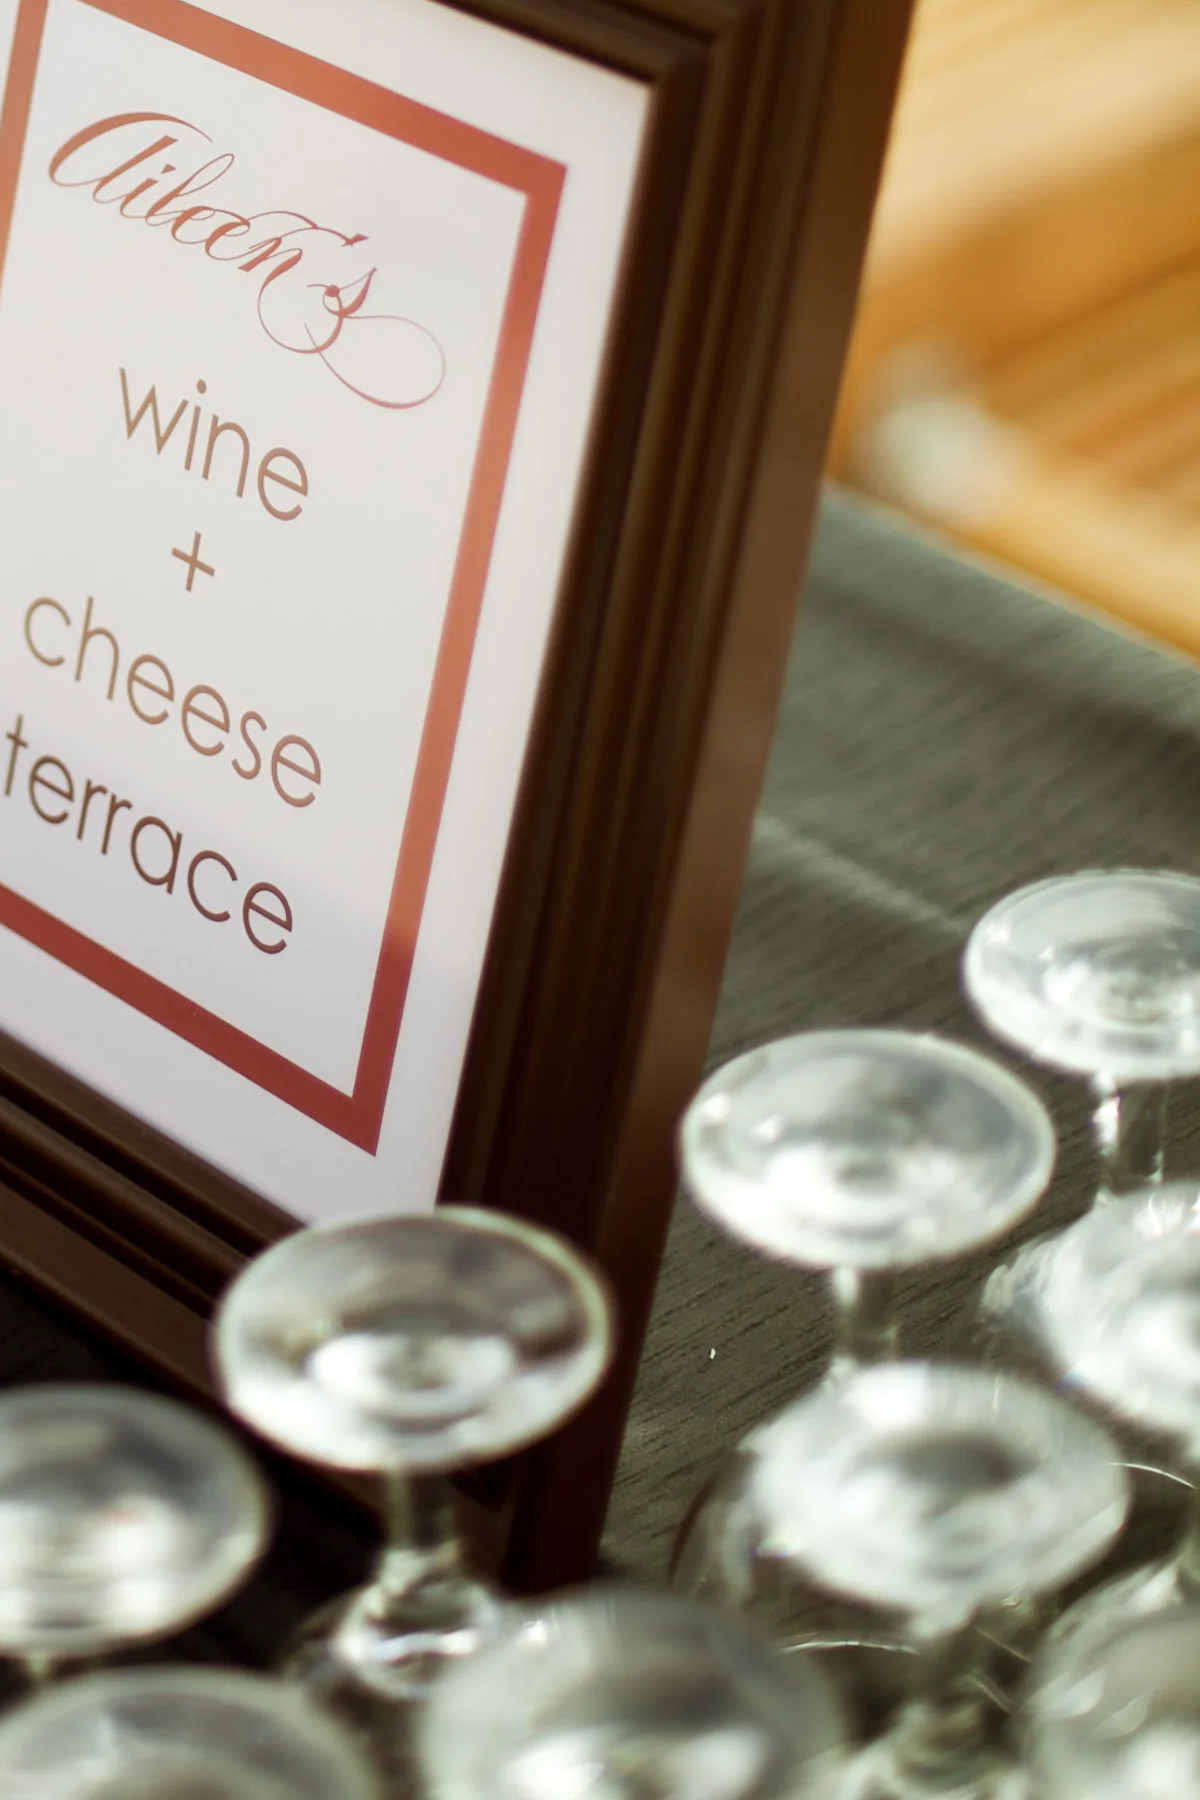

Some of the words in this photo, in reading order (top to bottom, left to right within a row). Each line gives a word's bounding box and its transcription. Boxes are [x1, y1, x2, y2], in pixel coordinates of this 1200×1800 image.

[48, 111, 446, 410] Aileen's
[119, 367, 309, 521] wine
[171, 531, 216, 593] +
[24, 596, 322, 808] cheese
[4, 713, 293, 955] terrace
